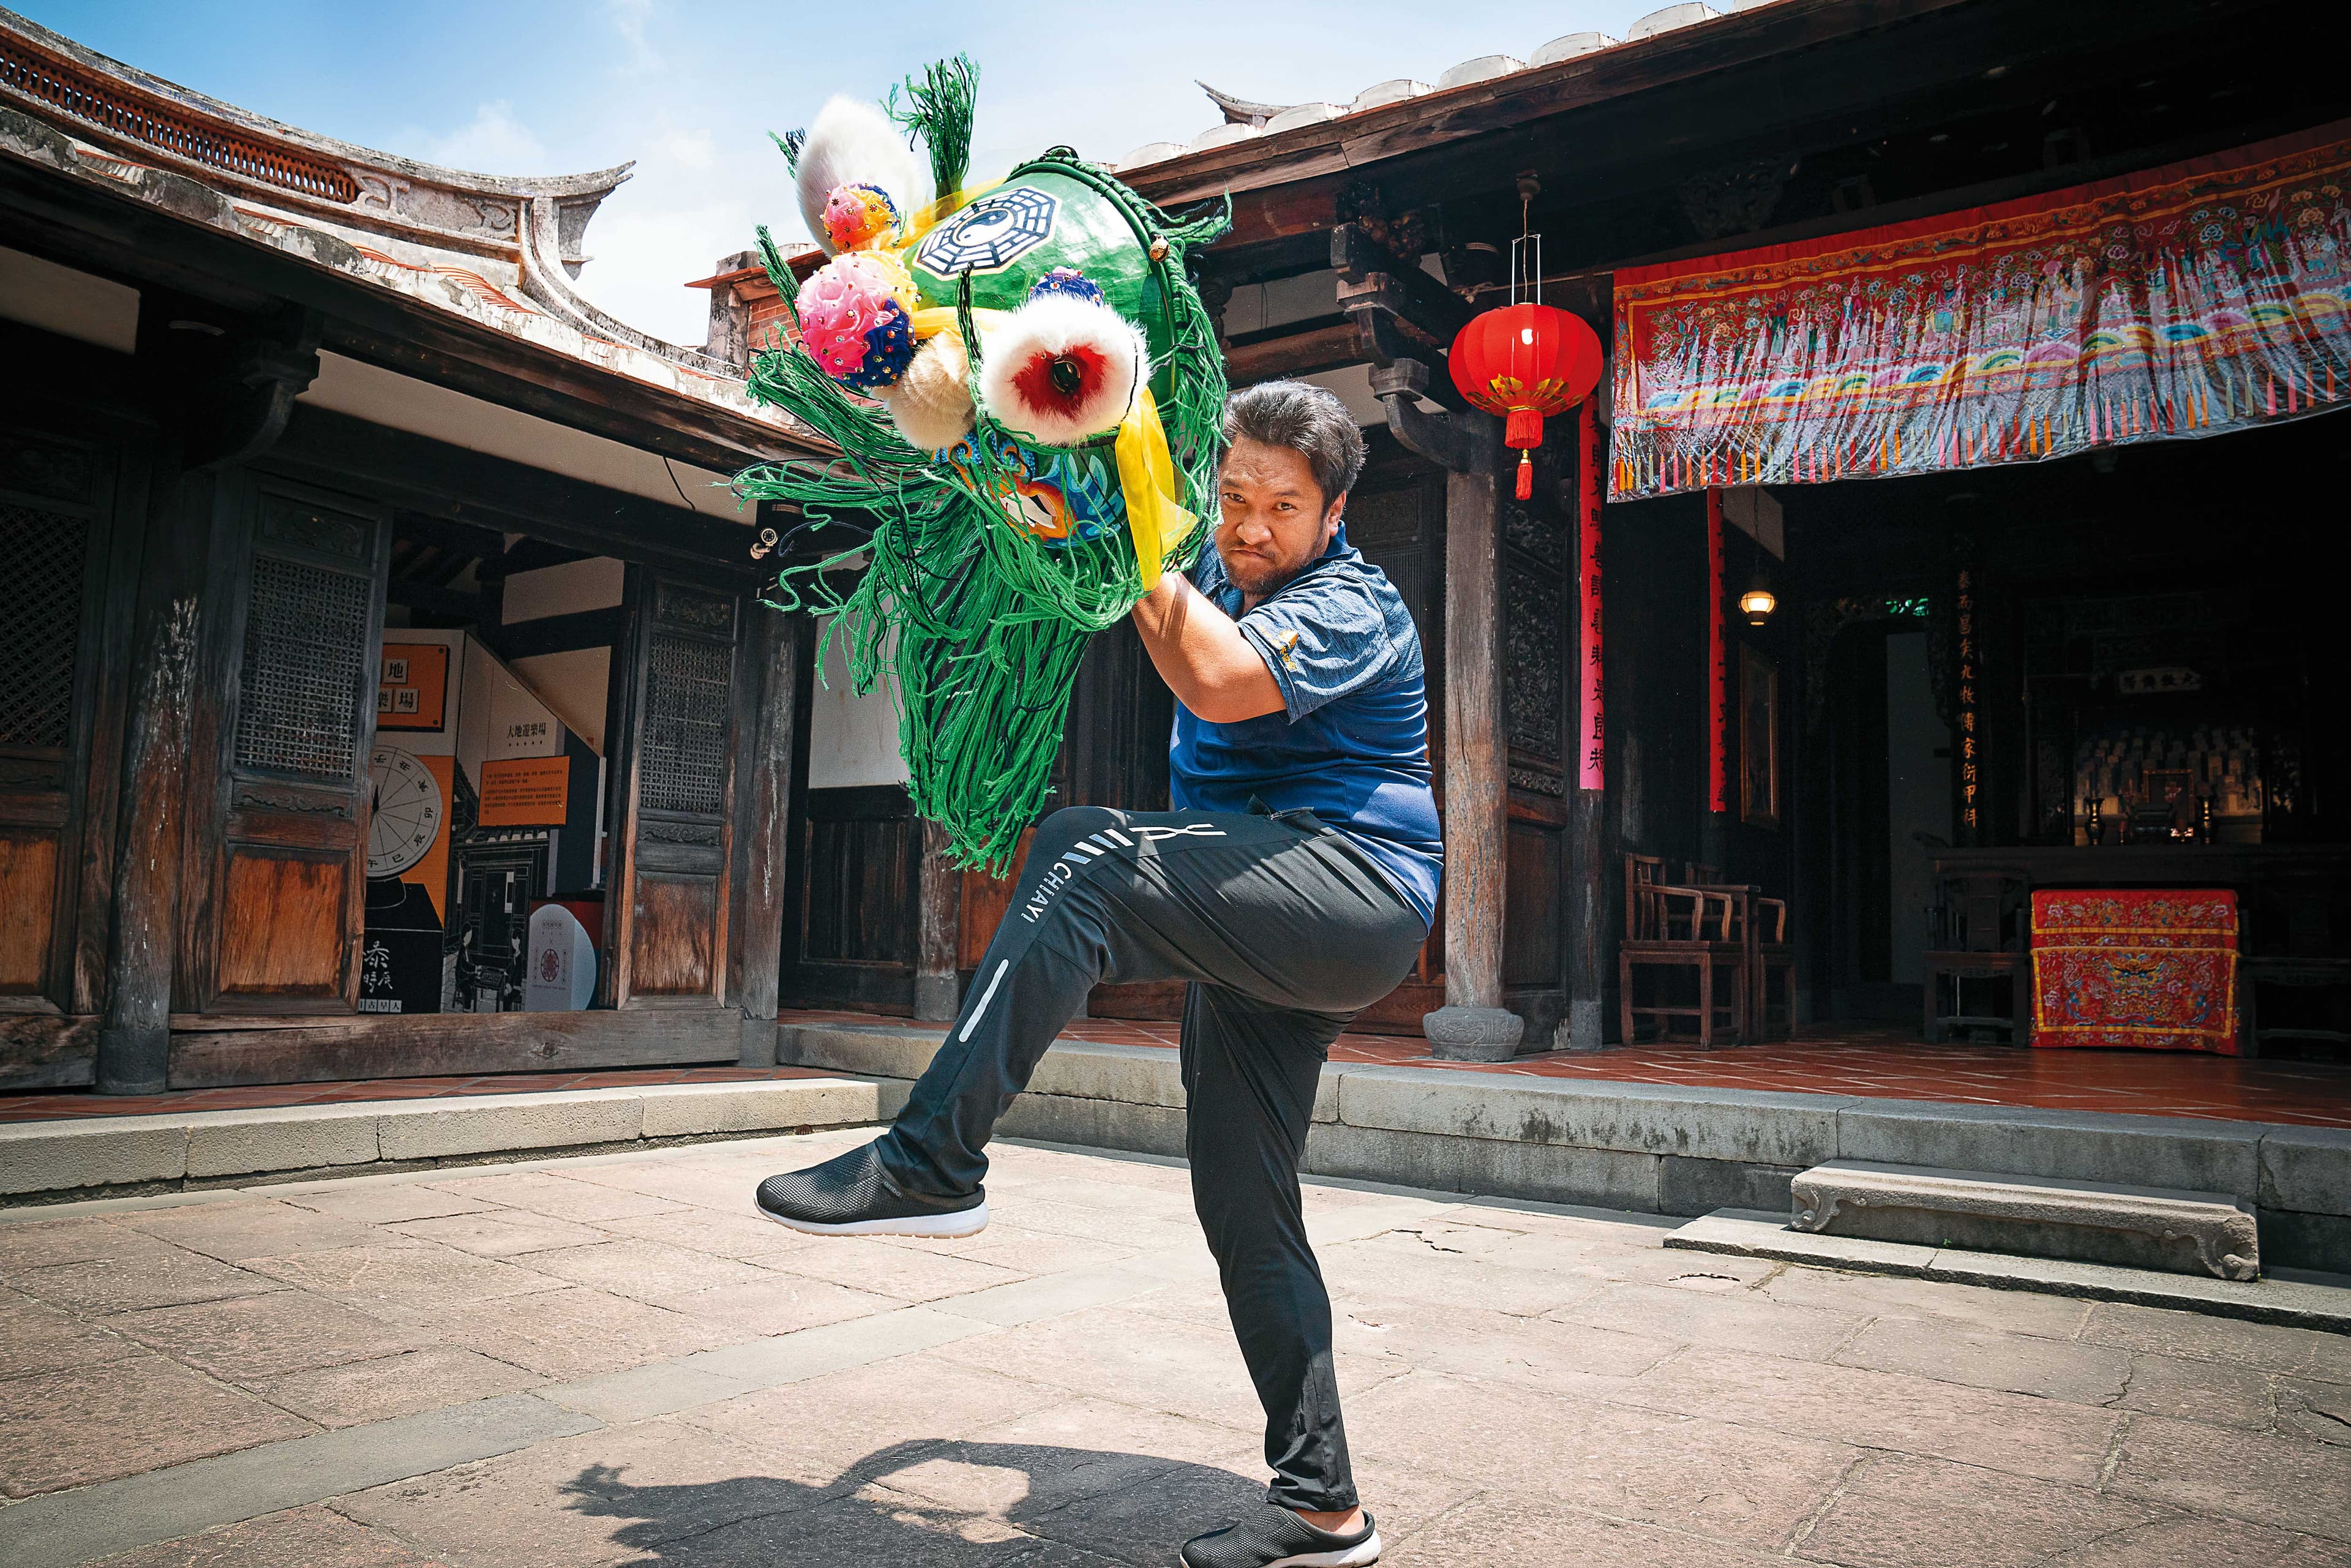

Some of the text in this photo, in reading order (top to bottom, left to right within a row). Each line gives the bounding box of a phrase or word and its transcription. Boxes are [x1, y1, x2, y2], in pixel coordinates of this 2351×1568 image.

[388, 662, 403, 678] 地
[507, 722, 546, 740] 大地遊樂場
[424, 807, 433, 819] 卯
[1021, 862, 1072, 923] CHIAYI
[362, 940, 390, 969] 泰
[361, 1000, 400, 1010] 古早人
